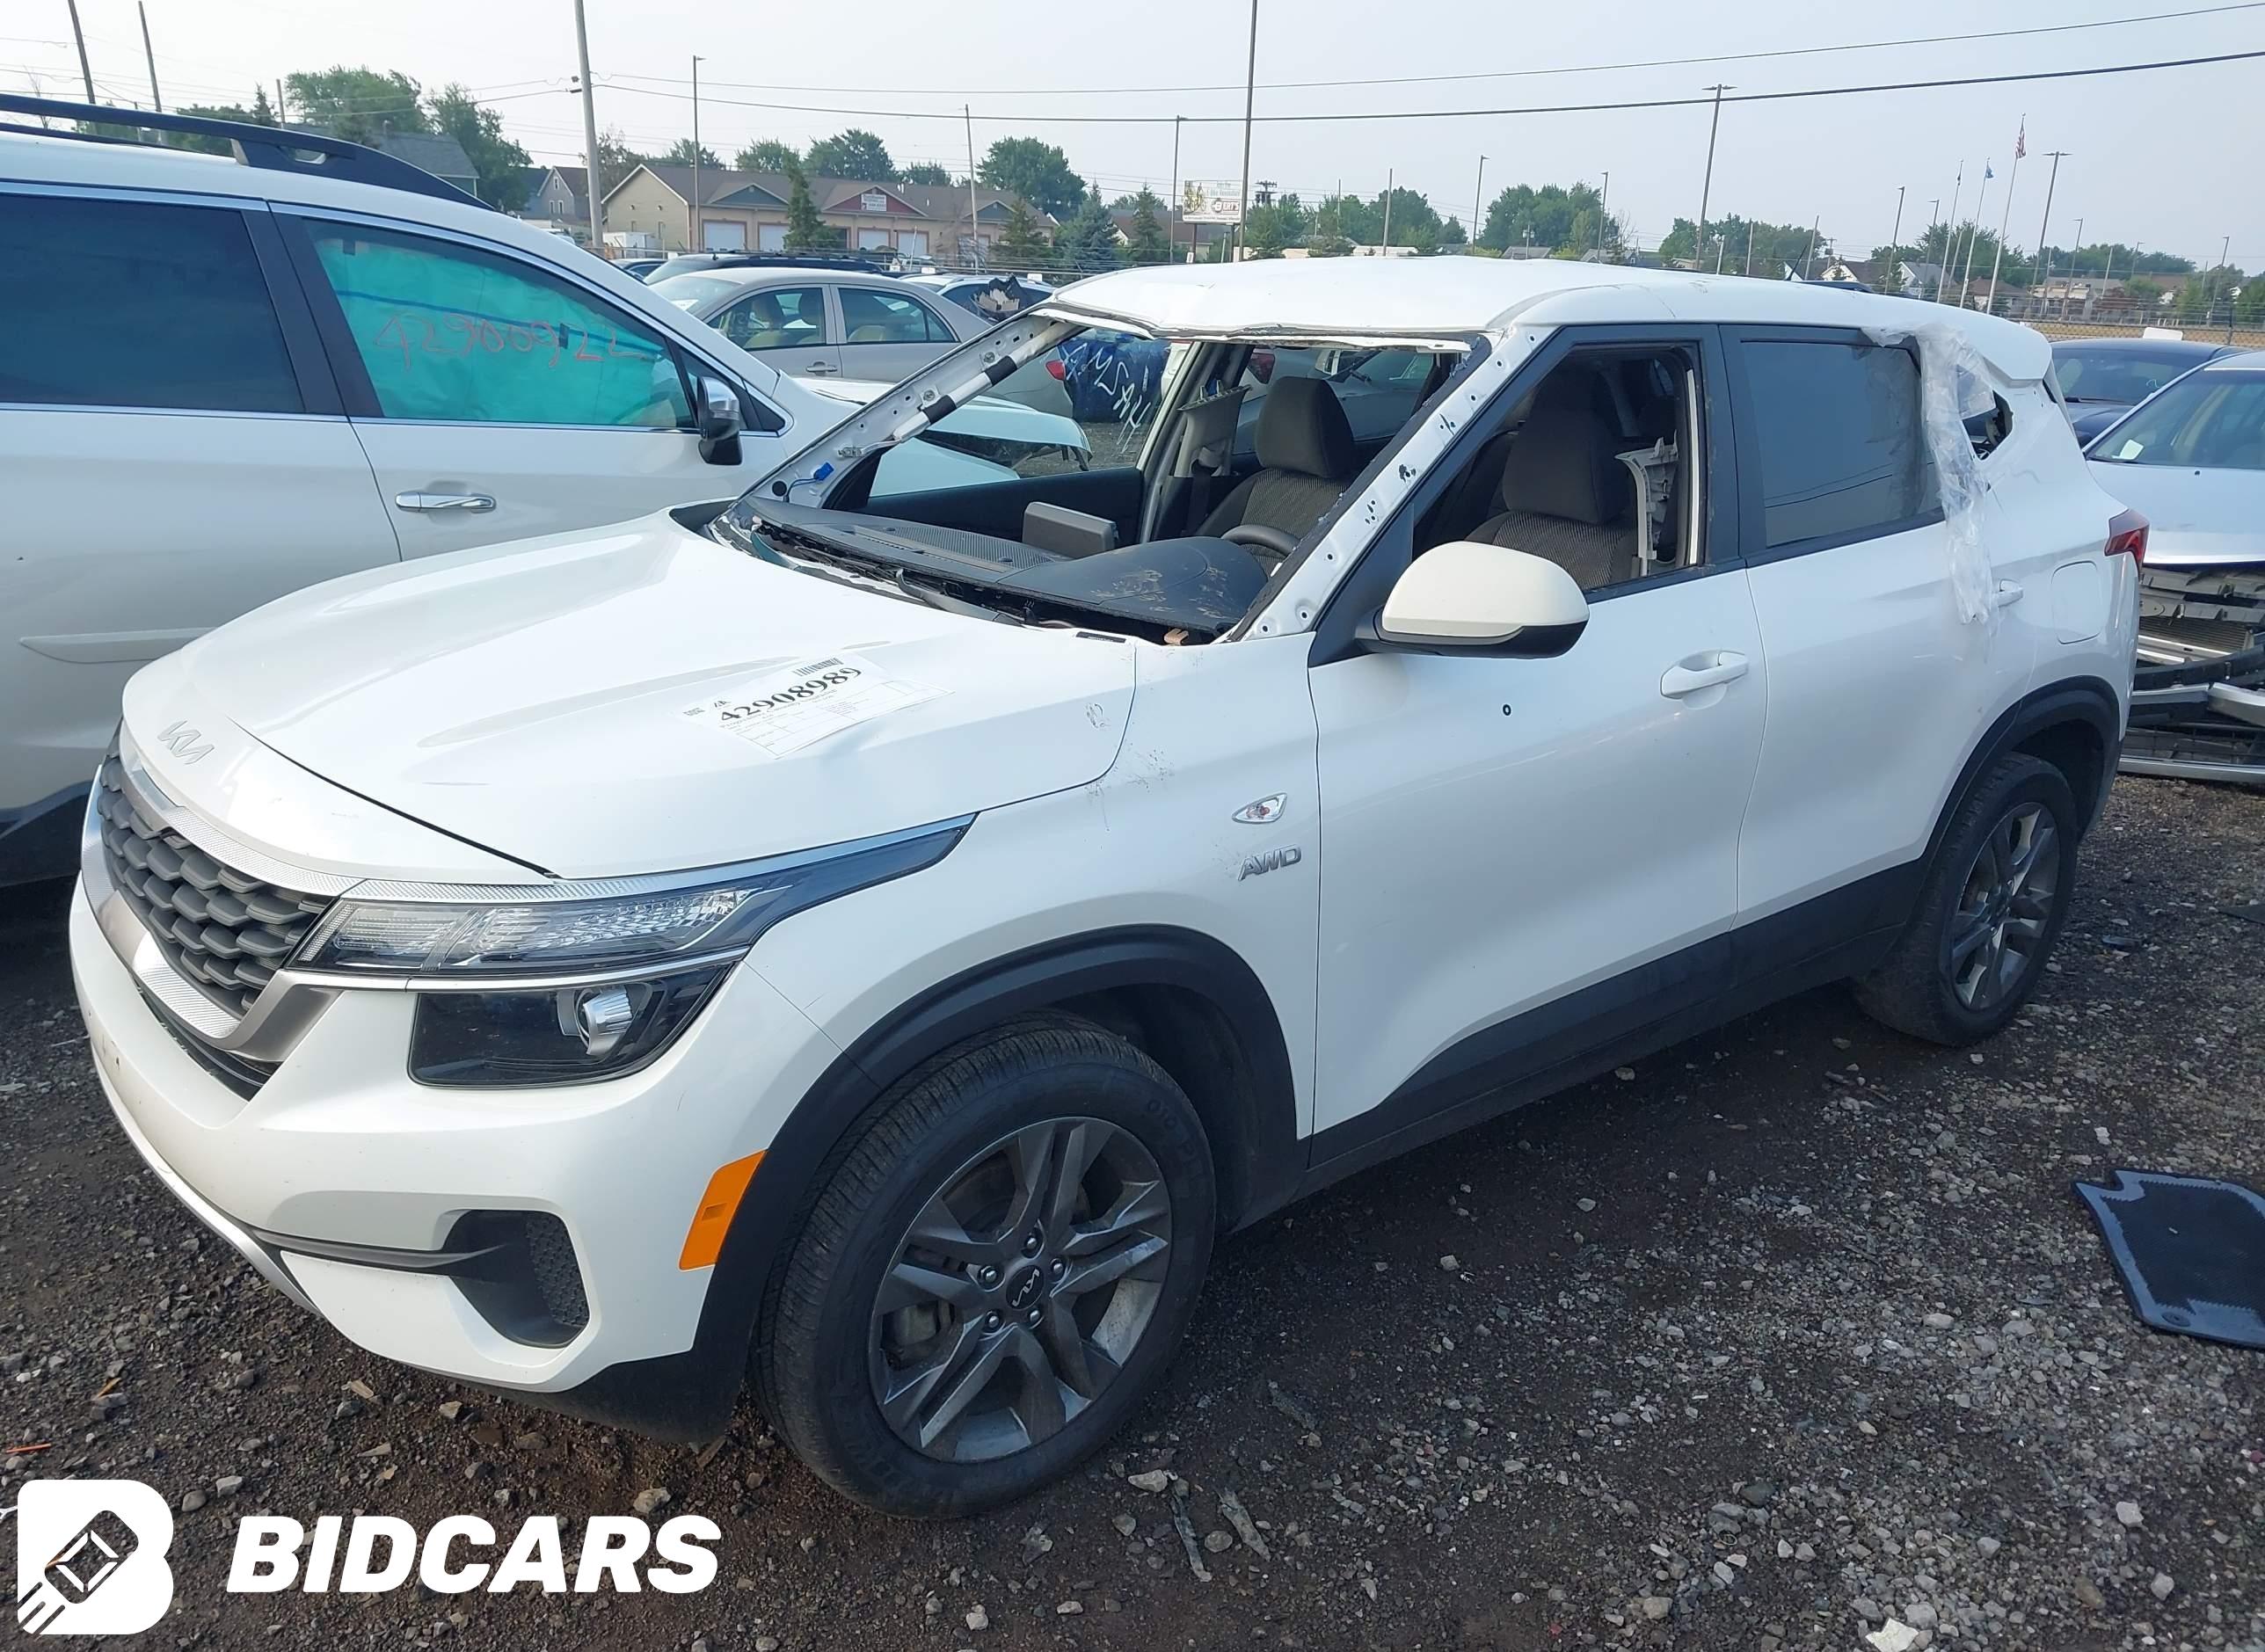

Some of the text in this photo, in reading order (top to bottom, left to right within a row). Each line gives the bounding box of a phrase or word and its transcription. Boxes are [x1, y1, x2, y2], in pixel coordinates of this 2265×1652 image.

[721, 667, 862, 721] 42908989
[157, 719, 215, 765] KIA
[1237, 844, 1302, 882] AWD
